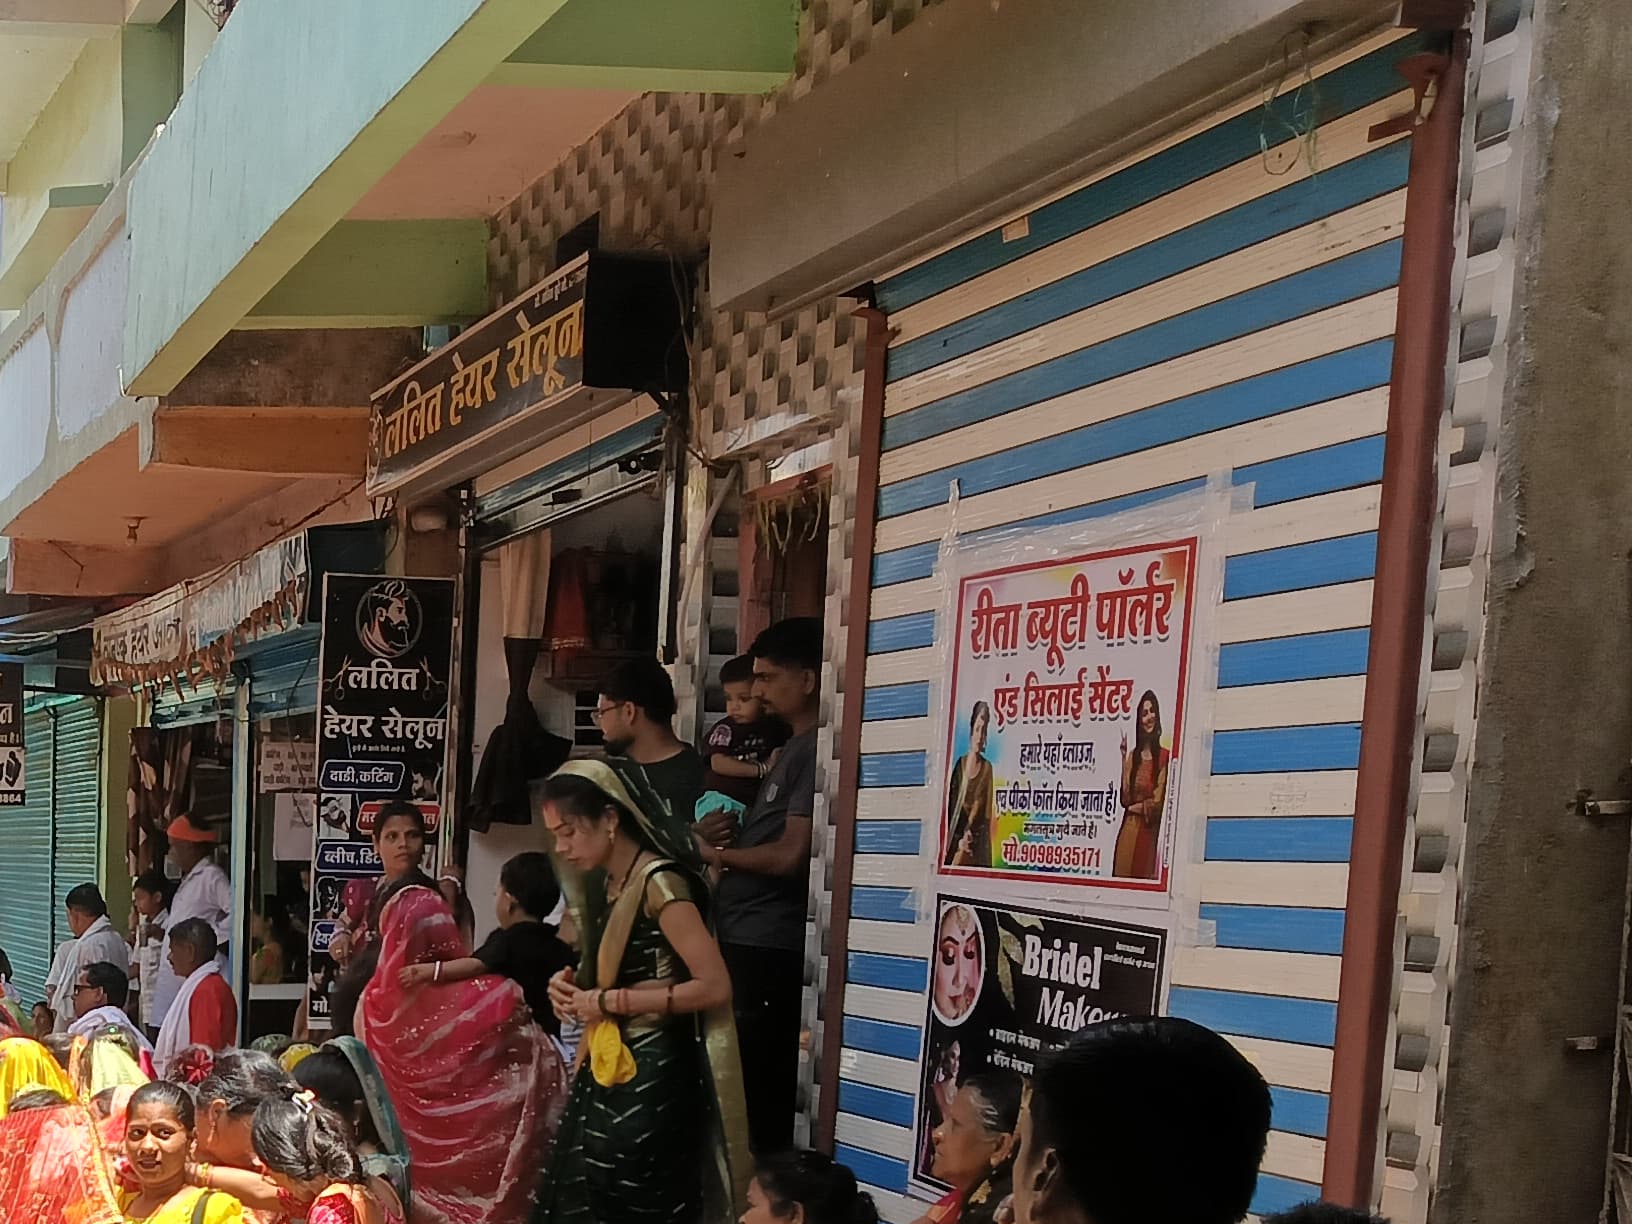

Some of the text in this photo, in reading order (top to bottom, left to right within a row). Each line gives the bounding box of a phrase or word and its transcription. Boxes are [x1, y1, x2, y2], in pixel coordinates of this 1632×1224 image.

[384, 310, 584, 459] ललित हेयर सेलून
[971, 587, 1022, 655] रीता
[1026, 573, 1092, 669] ब्यूटी
[347, 658, 420, 691] ललित
[994, 665, 1134, 727] एंड सिलाई सेंटर
[323, 705, 447, 749] हेयर सेलून
[1019, 733, 1043, 769] हमारे
[1055, 780, 1079, 812] किया
[1081, 790, 1105, 813] जाता
[1022, 934, 1103, 990] Bridel
[1036, 986, 1128, 1032] Make
